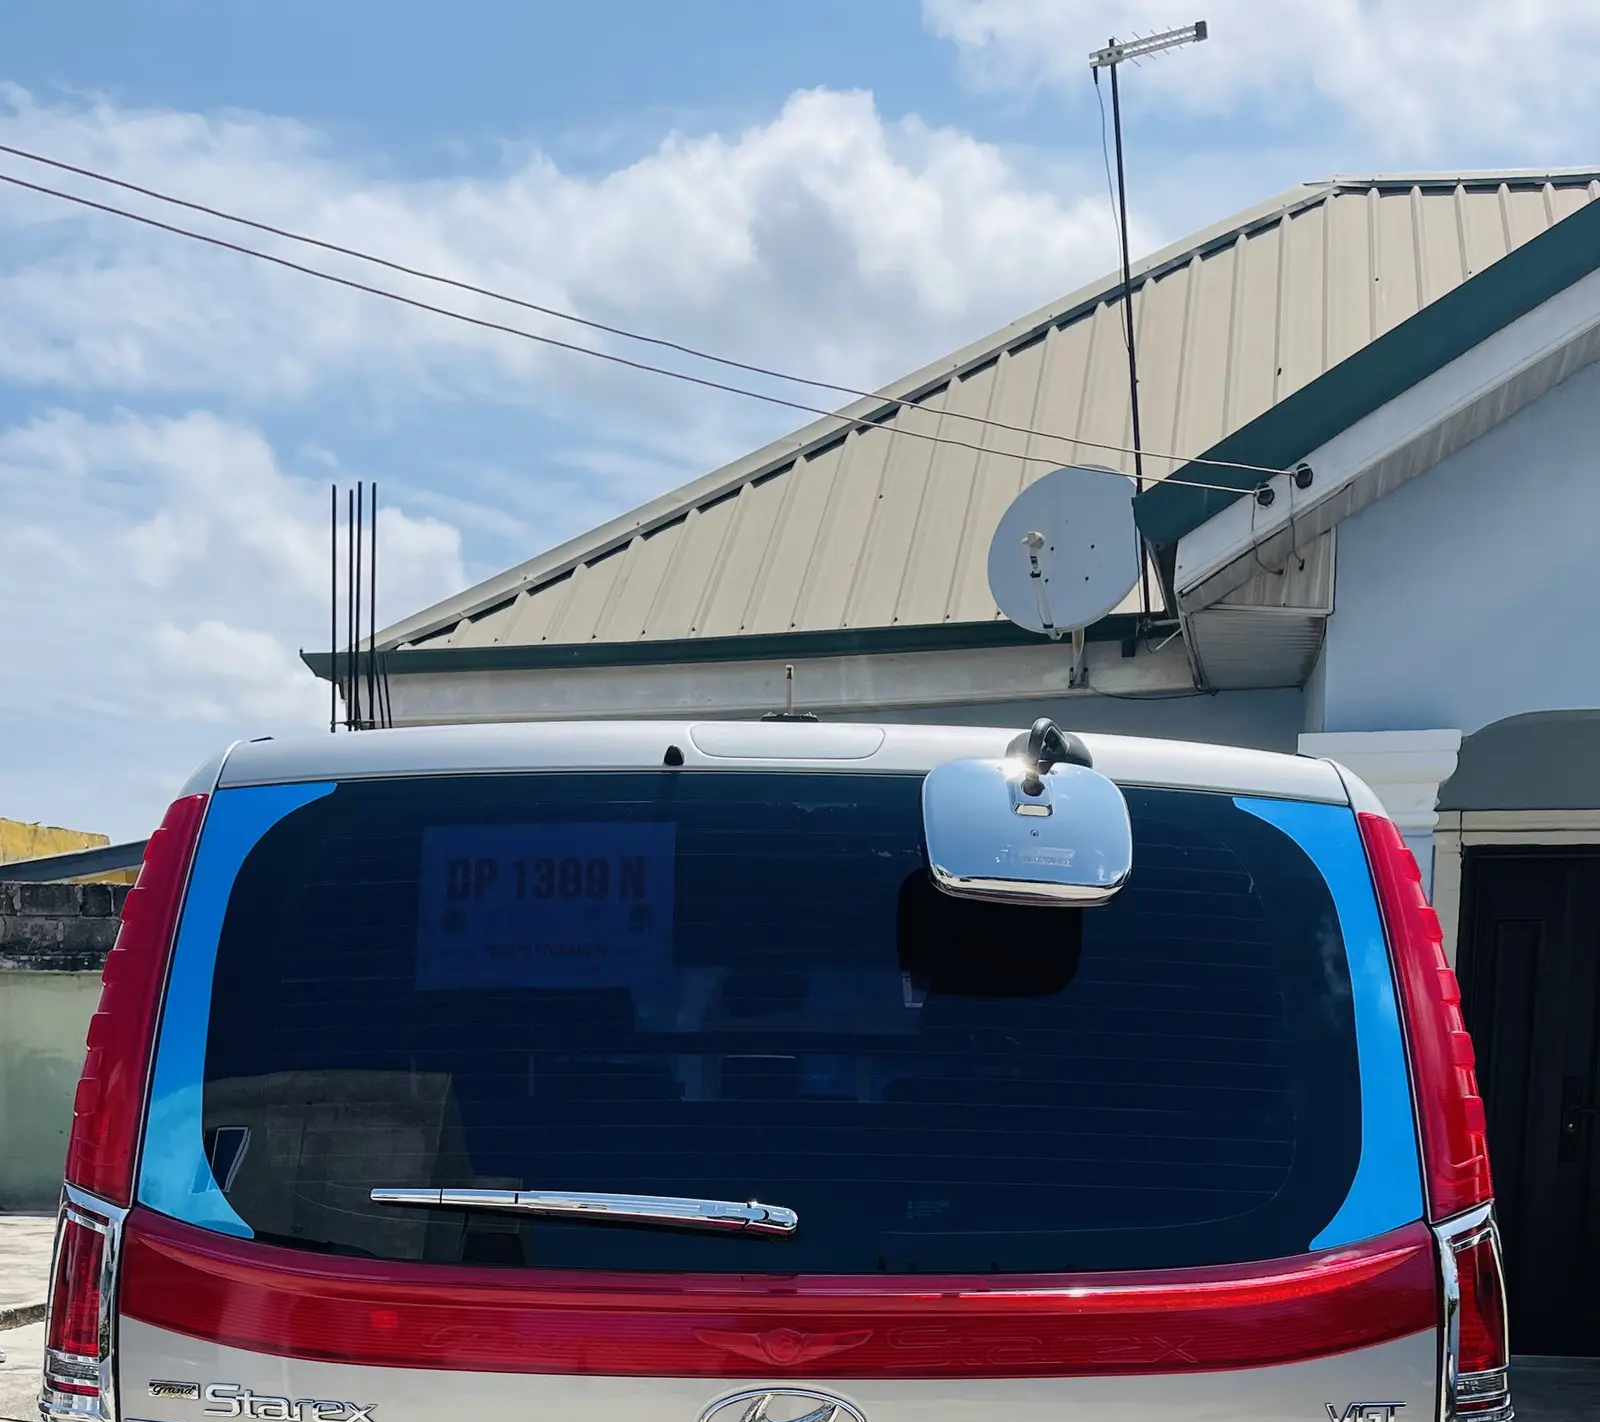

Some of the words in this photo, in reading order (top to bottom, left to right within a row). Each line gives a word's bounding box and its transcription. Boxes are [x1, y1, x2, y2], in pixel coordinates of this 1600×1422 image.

[445, 857, 498, 901] DP
[619, 856, 647, 901] N
[885, 1325, 1198, 1368] Starex
